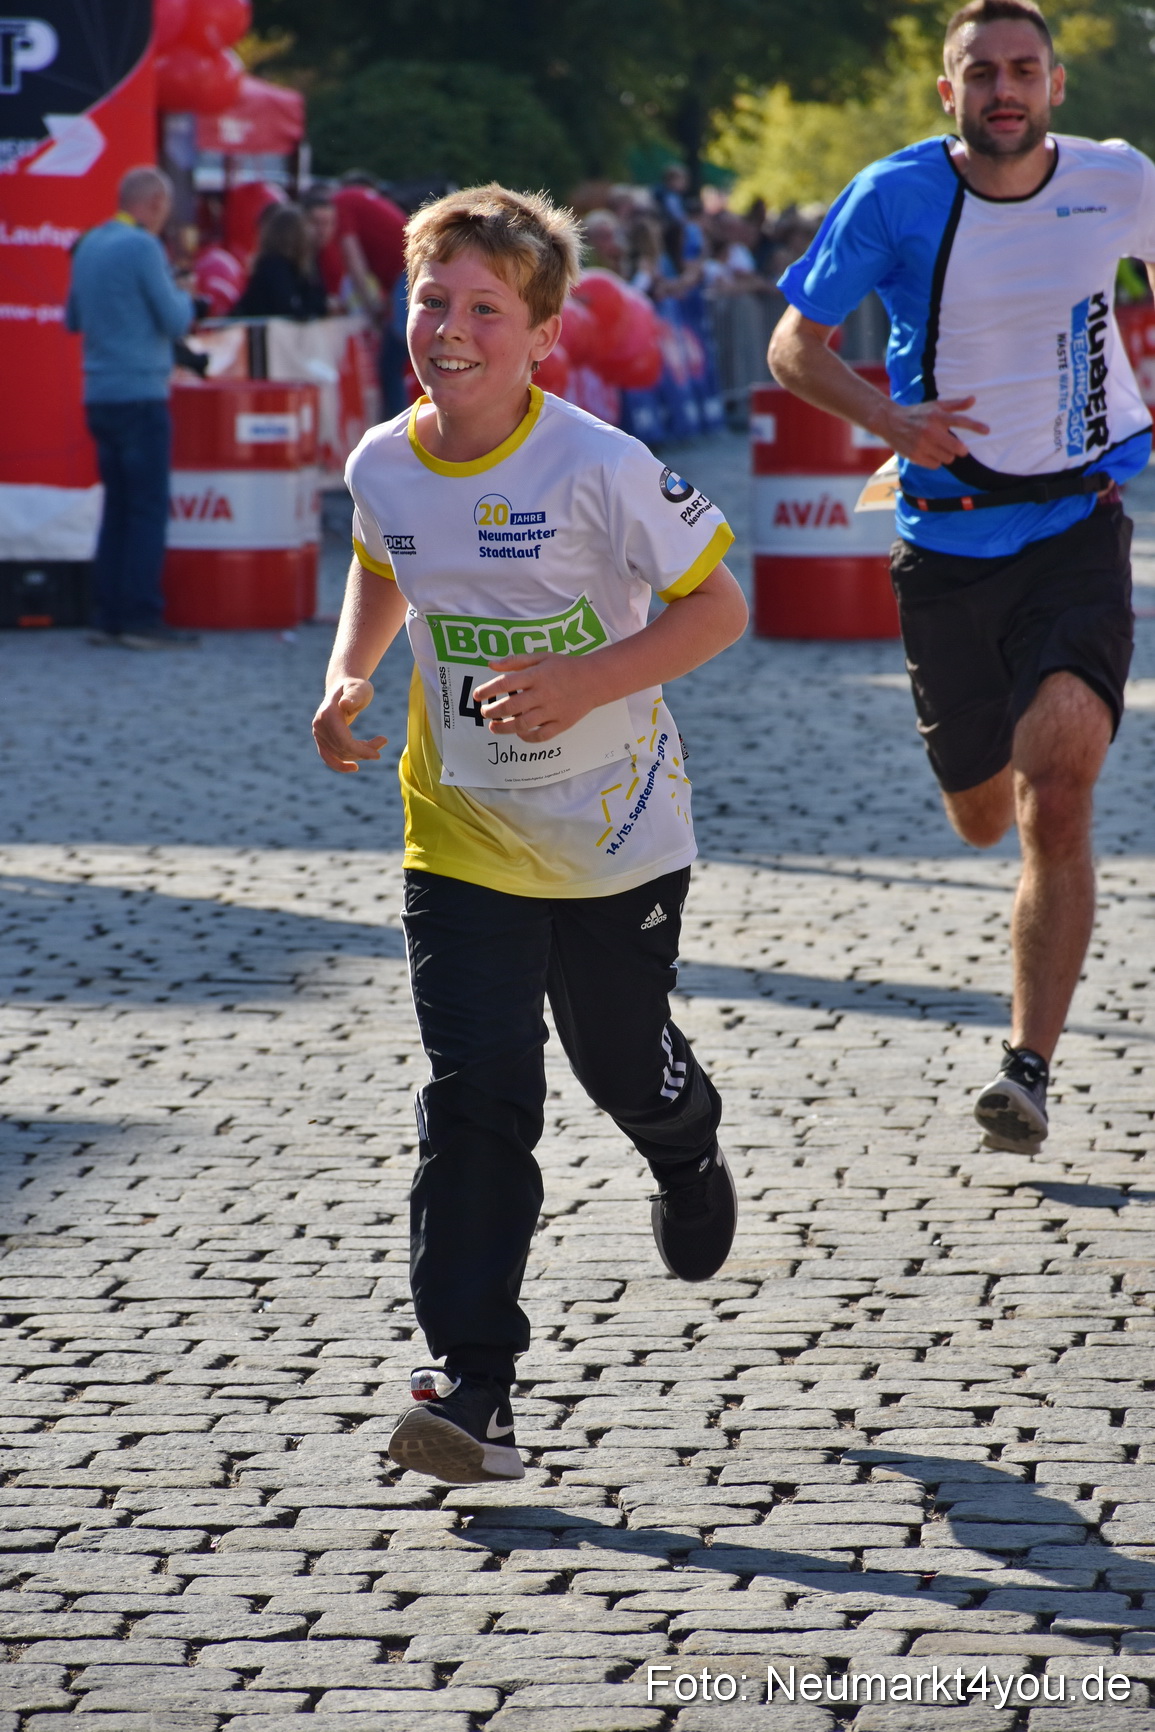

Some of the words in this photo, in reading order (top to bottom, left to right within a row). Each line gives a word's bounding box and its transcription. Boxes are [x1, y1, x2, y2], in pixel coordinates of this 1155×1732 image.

[1057, 333, 1068, 370] WASTE
[1058, 372, 1068, 411] WATER
[478, 503, 509, 526] 20
[512, 513, 543, 525] JAHRE
[478, 529, 557, 542] Neumarkter
[479, 544, 541, 559] Stadtlauf
[443, 611, 592, 658] BOCK
[488, 741, 562, 766] Johannes
[606, 823, 634, 855] 14./15.
[629, 760, 661, 821] September
[657, 733, 669, 760] 2019
[640, 913, 668, 930] adidas
